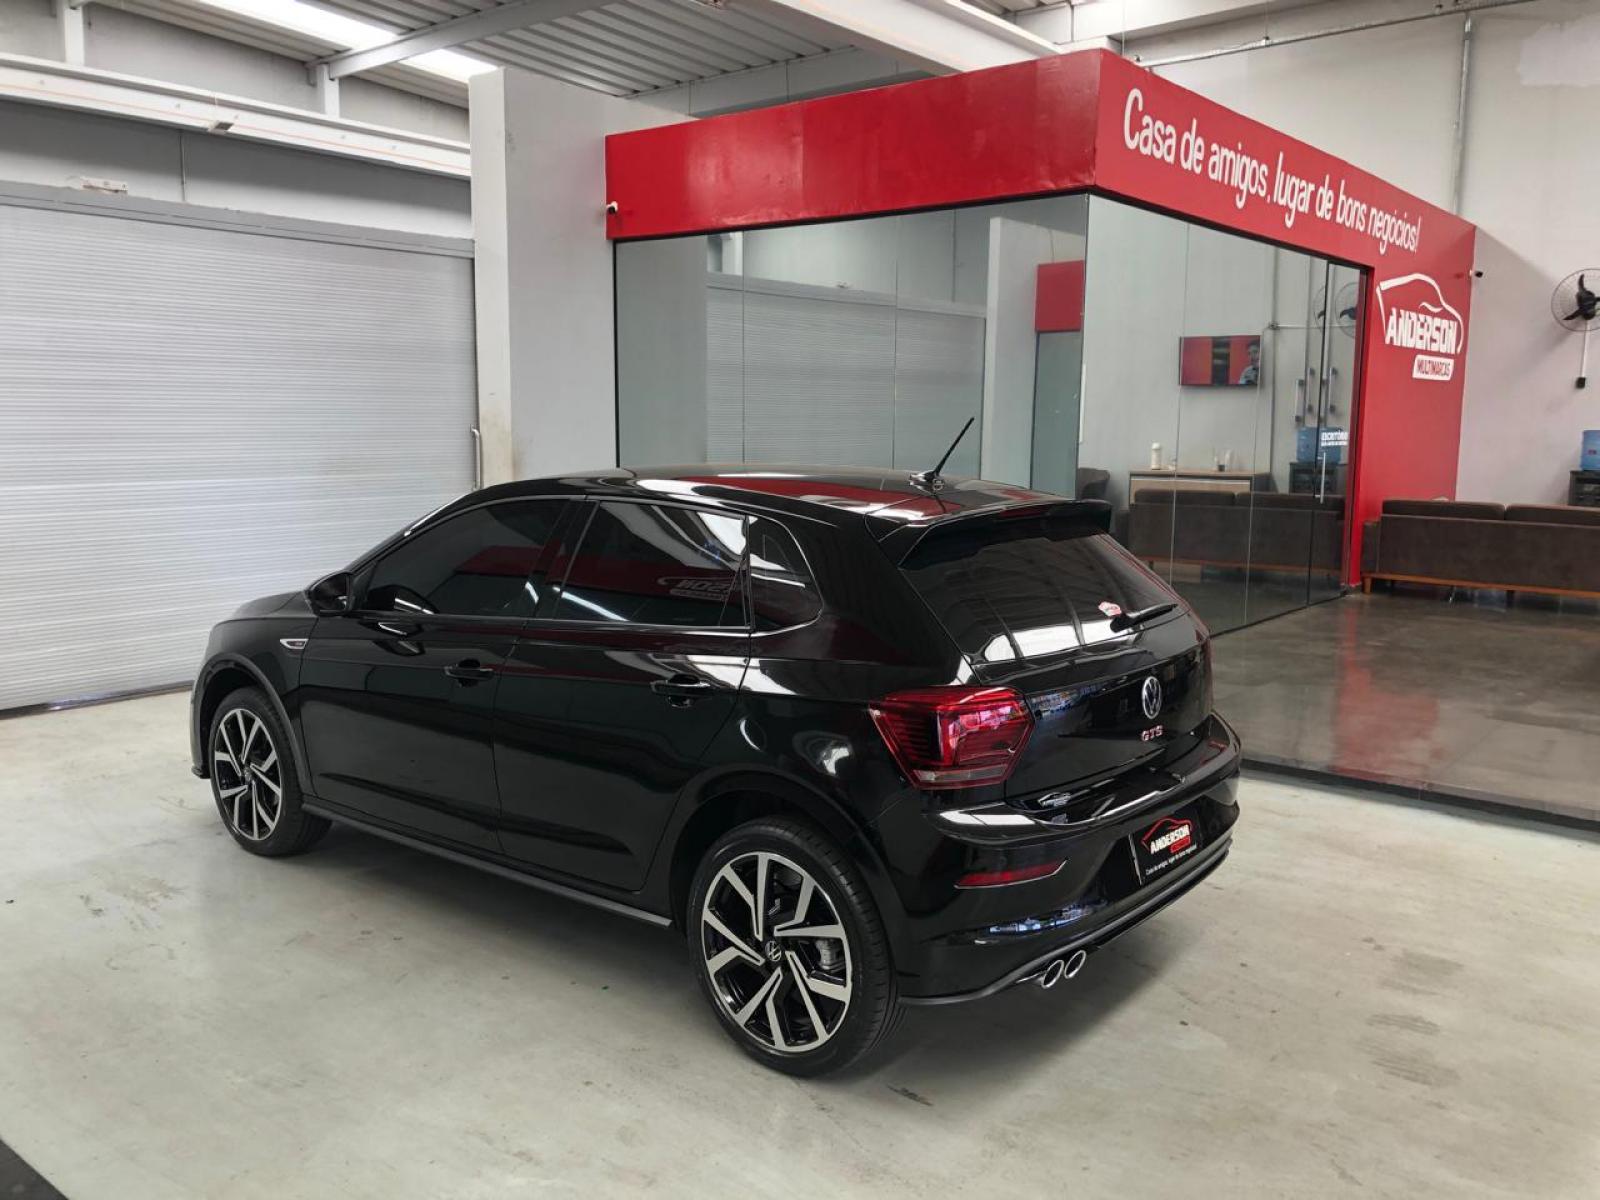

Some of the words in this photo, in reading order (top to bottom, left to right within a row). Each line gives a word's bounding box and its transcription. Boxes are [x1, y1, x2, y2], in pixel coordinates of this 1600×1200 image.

[1124, 88, 1176, 165] Casa
[1180, 117, 1205, 174] de
[1273, 151, 1316, 229] lugar
[1315, 174, 1334, 221] de
[1336, 179, 1367, 232] bons
[1385, 307, 1457, 354] ANDERSON
[1142, 725, 1163, 741] GTS
[1150, 824, 1190, 854] ANDERSON
